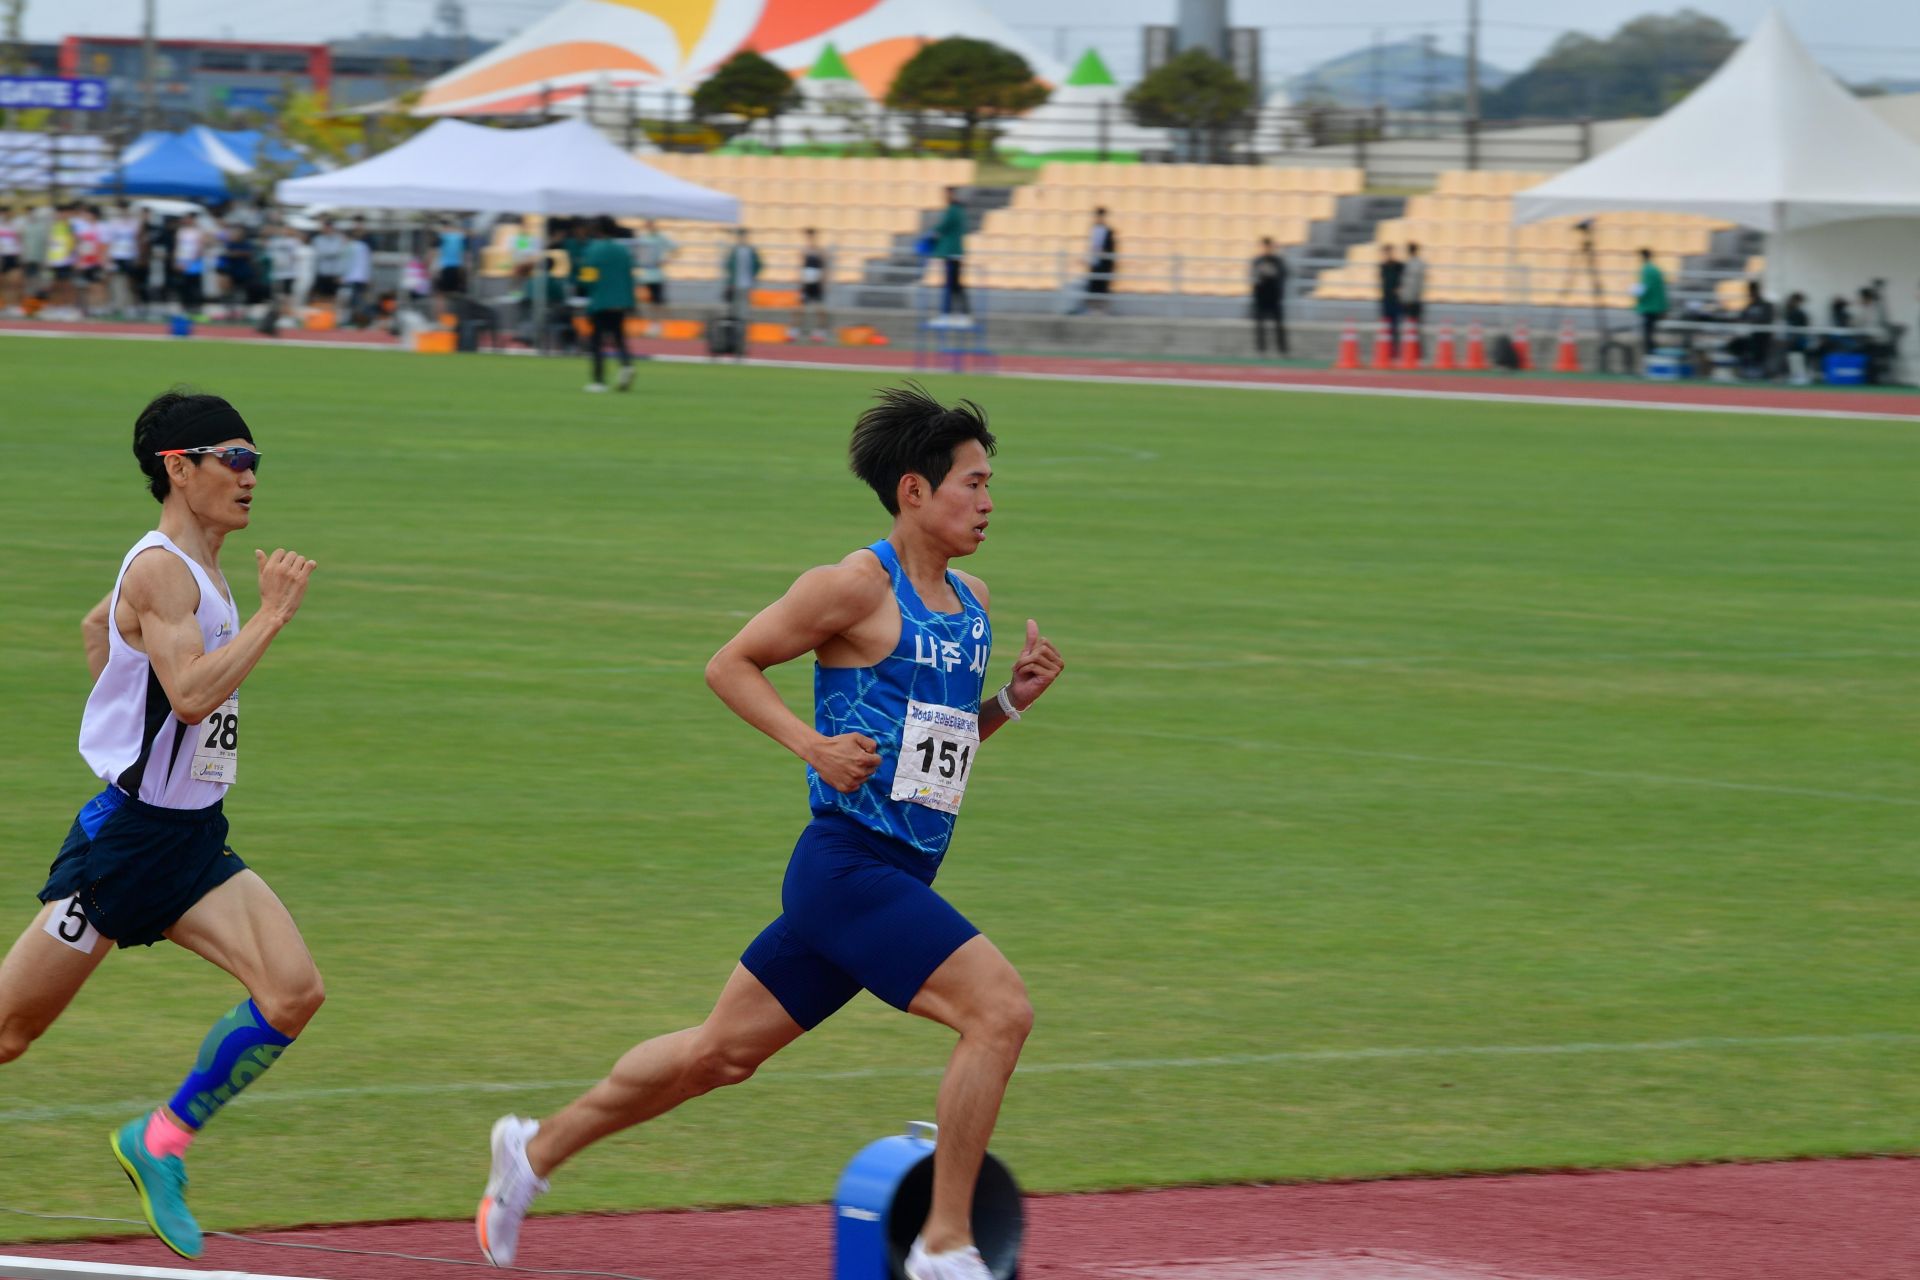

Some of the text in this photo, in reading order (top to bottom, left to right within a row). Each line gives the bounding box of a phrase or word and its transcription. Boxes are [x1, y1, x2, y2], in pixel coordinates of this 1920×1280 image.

[77, 82, 102, 107] 2
[205, 712, 238, 750] 28
[916, 736, 971, 782] 151
[59, 896, 88, 943] 5
